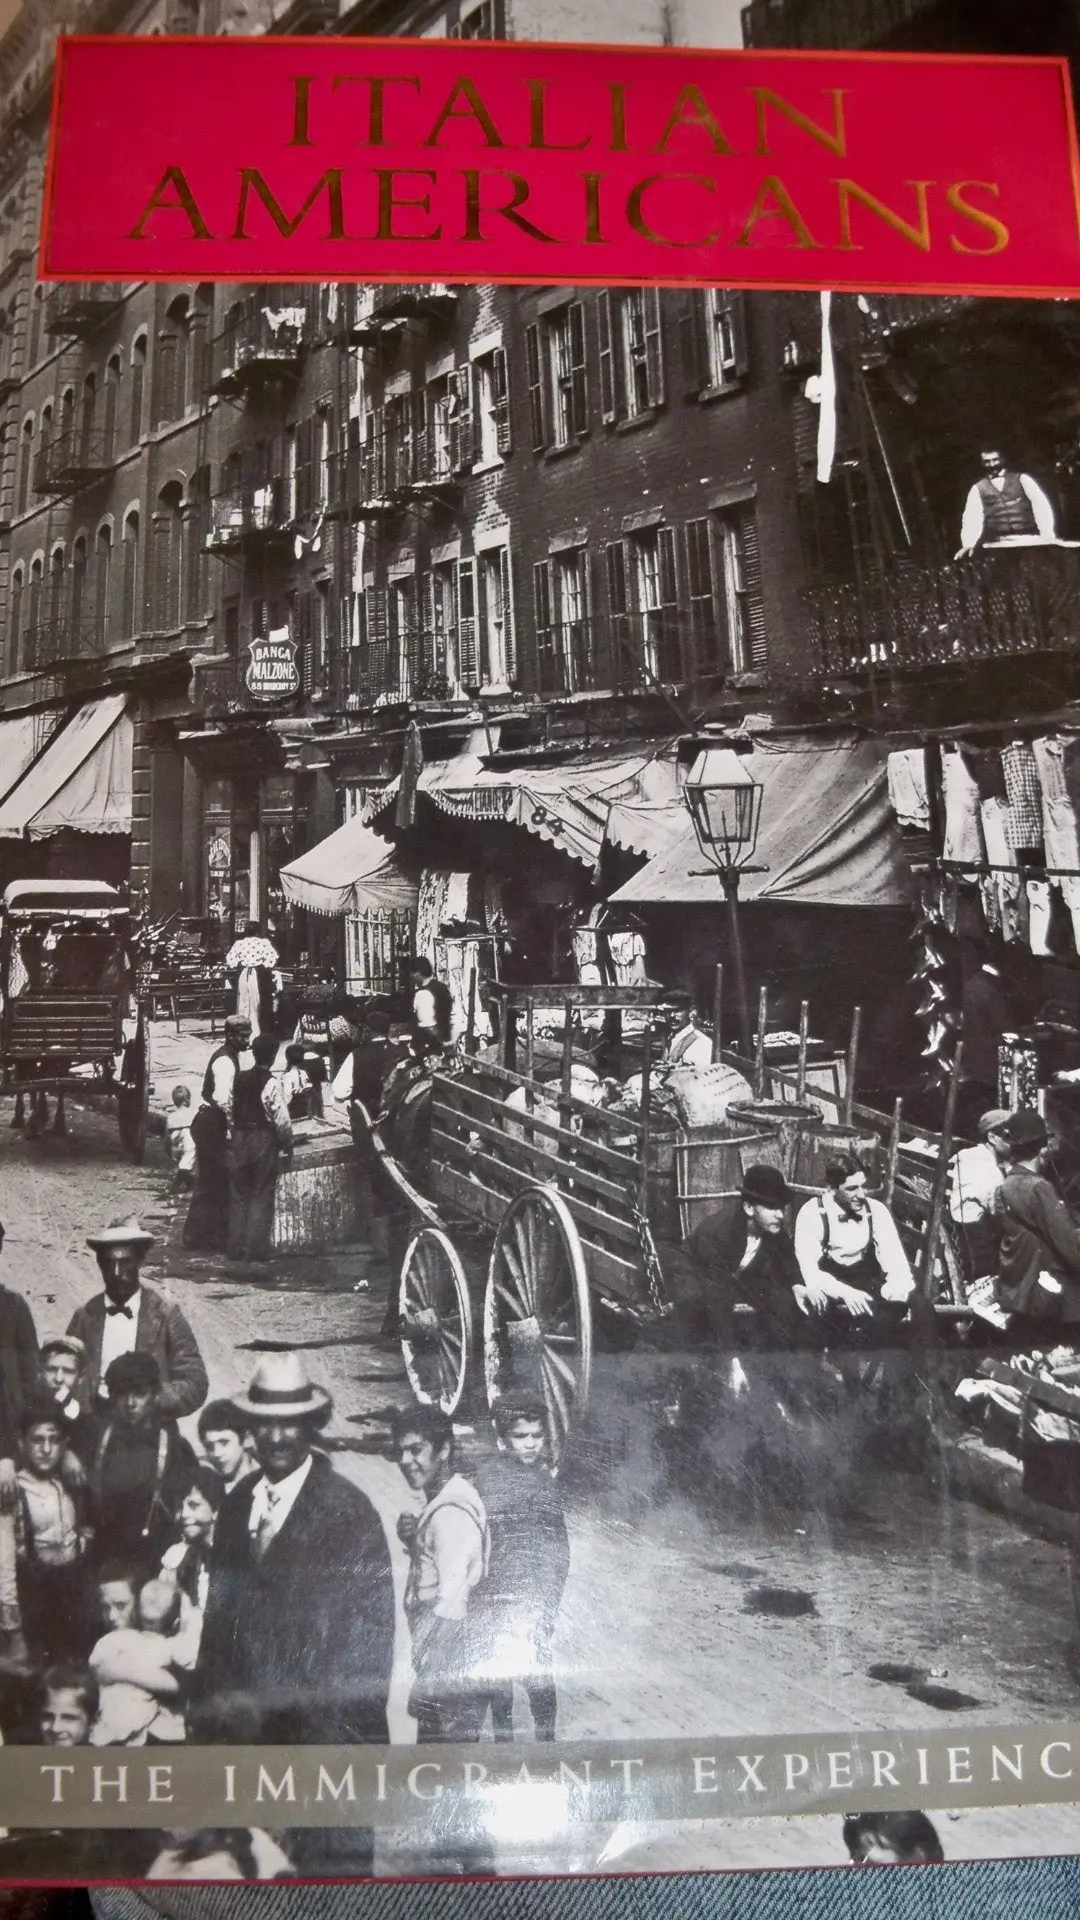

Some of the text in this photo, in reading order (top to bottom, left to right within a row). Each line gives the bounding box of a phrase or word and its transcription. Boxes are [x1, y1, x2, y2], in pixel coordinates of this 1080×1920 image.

[287, 74, 850, 158] ITALIAN
[123, 166, 1010, 255] AMERICANS
[255, 646, 291, 661] BANCA
[40, 1765, 174, 1802] THE
[692, 1742, 1073, 1794] EXPERIENC
